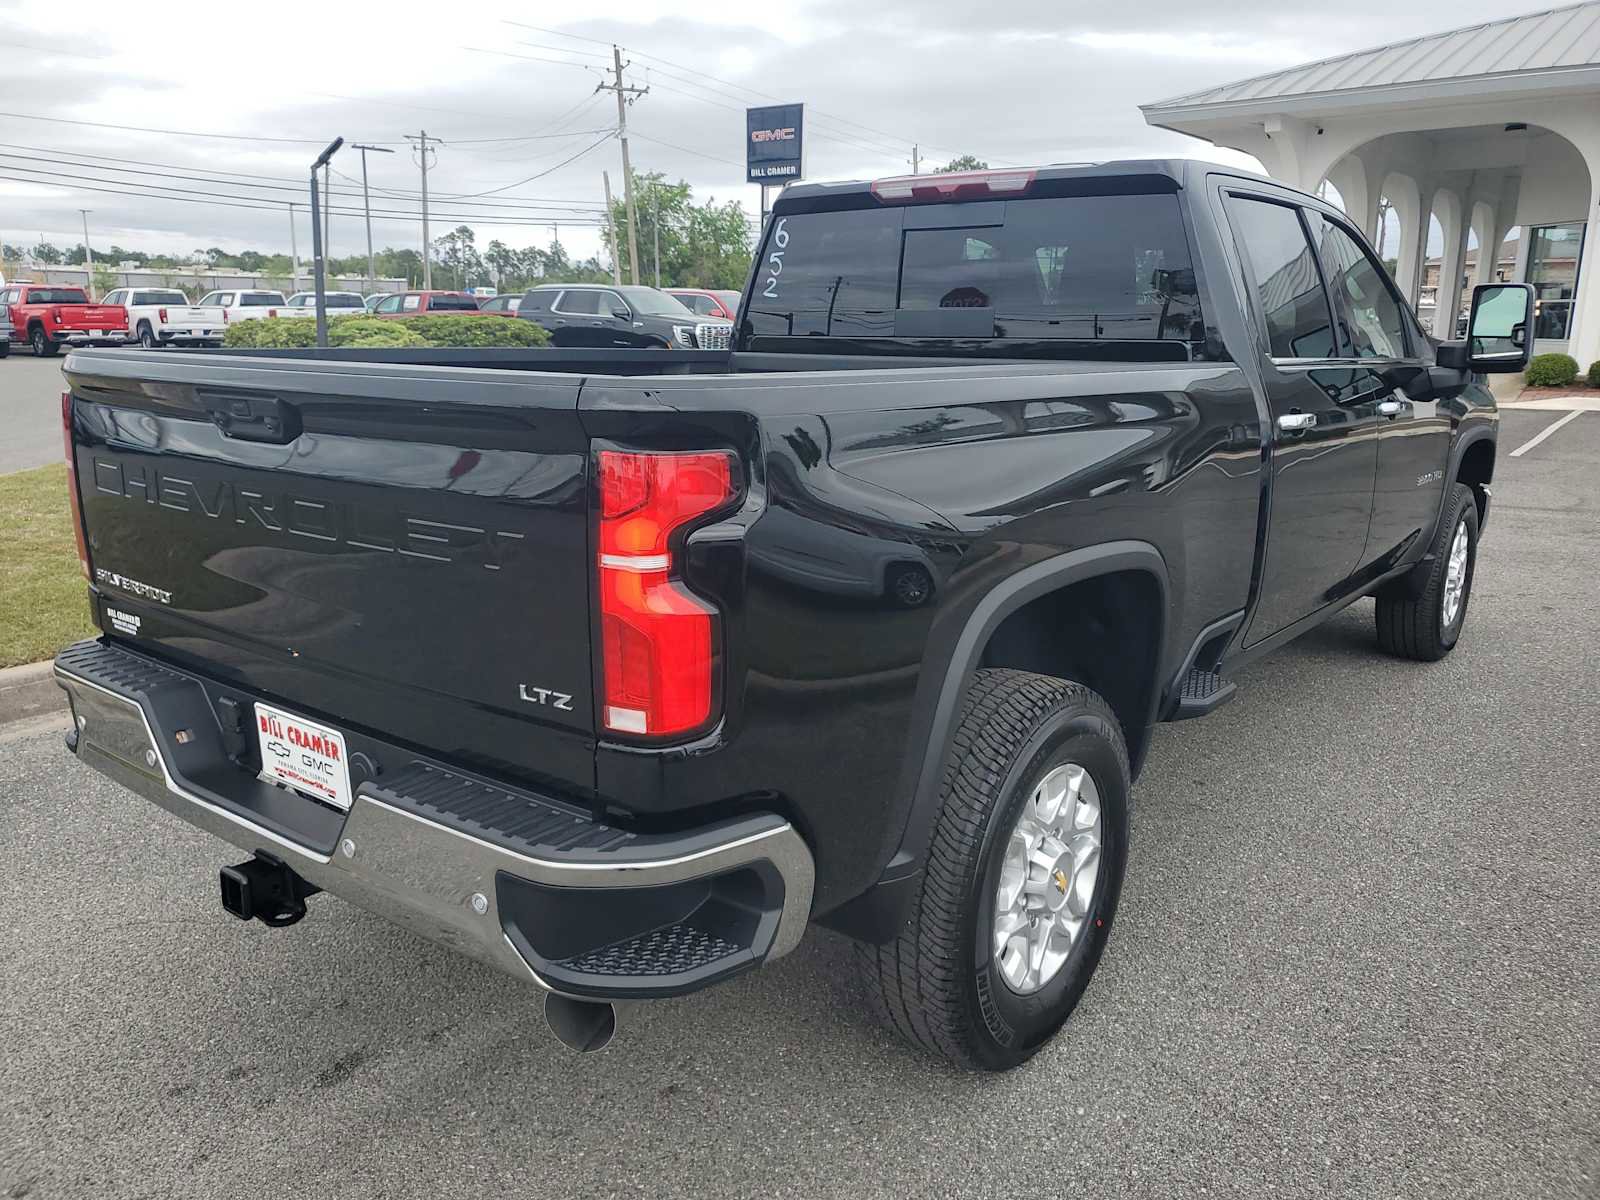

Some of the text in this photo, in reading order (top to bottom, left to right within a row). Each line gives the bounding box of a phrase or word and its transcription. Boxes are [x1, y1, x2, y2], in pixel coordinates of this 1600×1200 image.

[751, 128, 795, 142] GMC
[750, 166, 796, 177] BILL CRAMER
[93, 456, 526, 571] CHEVROLET
[96, 568, 172, 604] SILVERADO
[519, 683, 574, 711] LTZ
[260, 715, 341, 762] BILL CRAMER
[302, 754, 334, 776] GMC
[976, 975, 1014, 1047] MICHELIN
